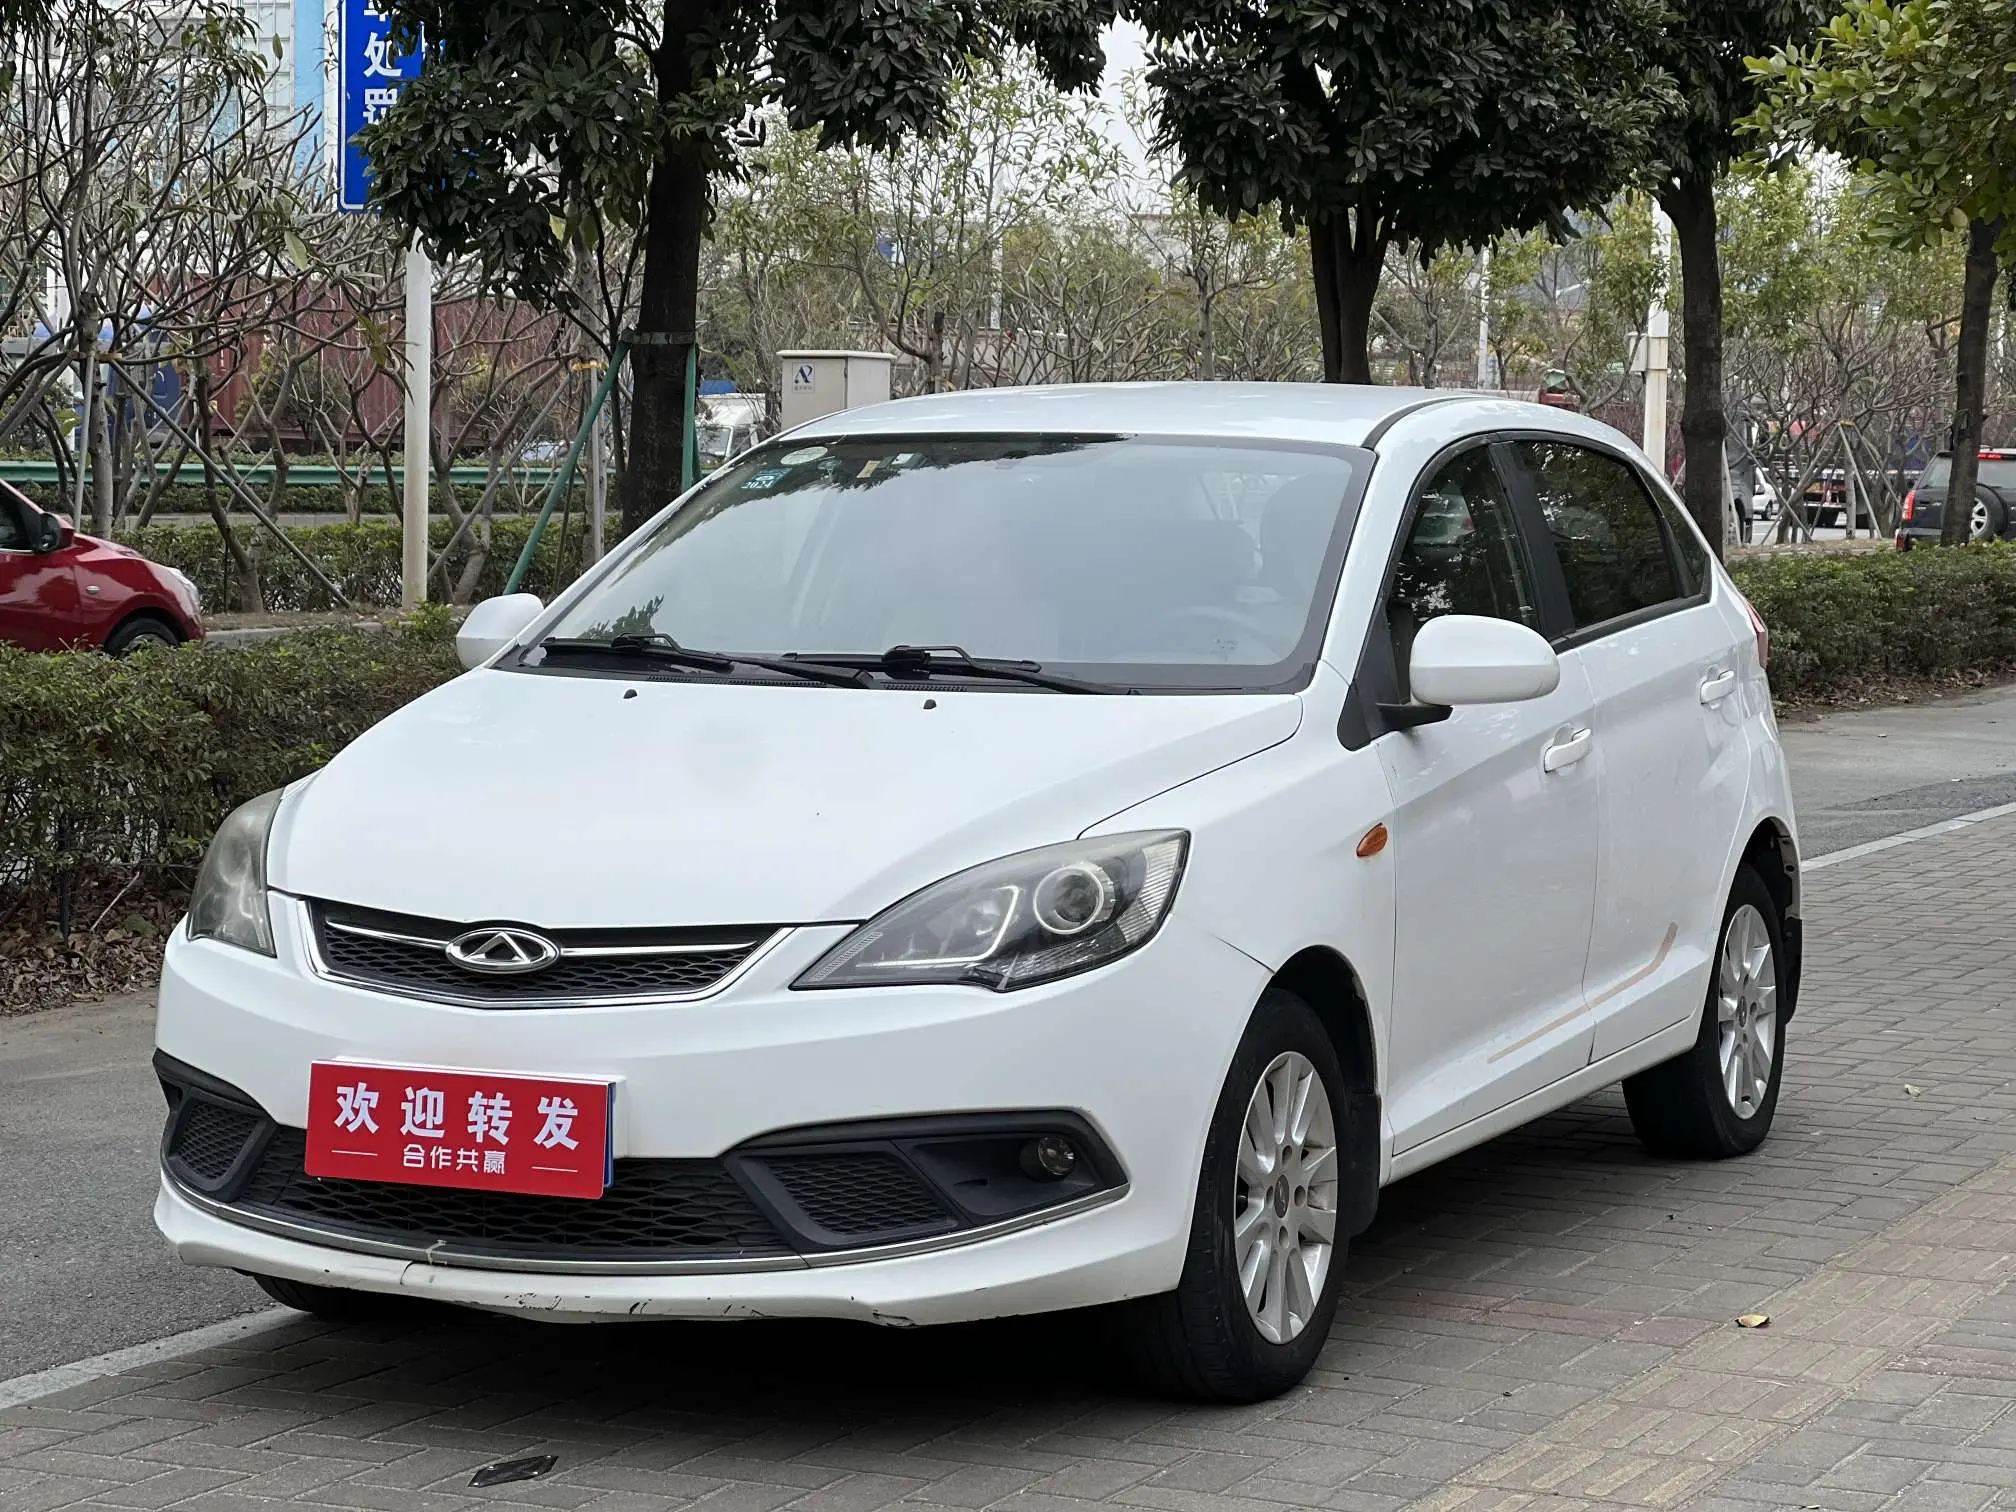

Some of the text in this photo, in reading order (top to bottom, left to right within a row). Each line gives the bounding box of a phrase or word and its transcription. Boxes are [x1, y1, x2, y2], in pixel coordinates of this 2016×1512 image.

[334, 1082, 579, 1150] 欢迎转发
[403, 1143, 505, 1174] 合作共赢
